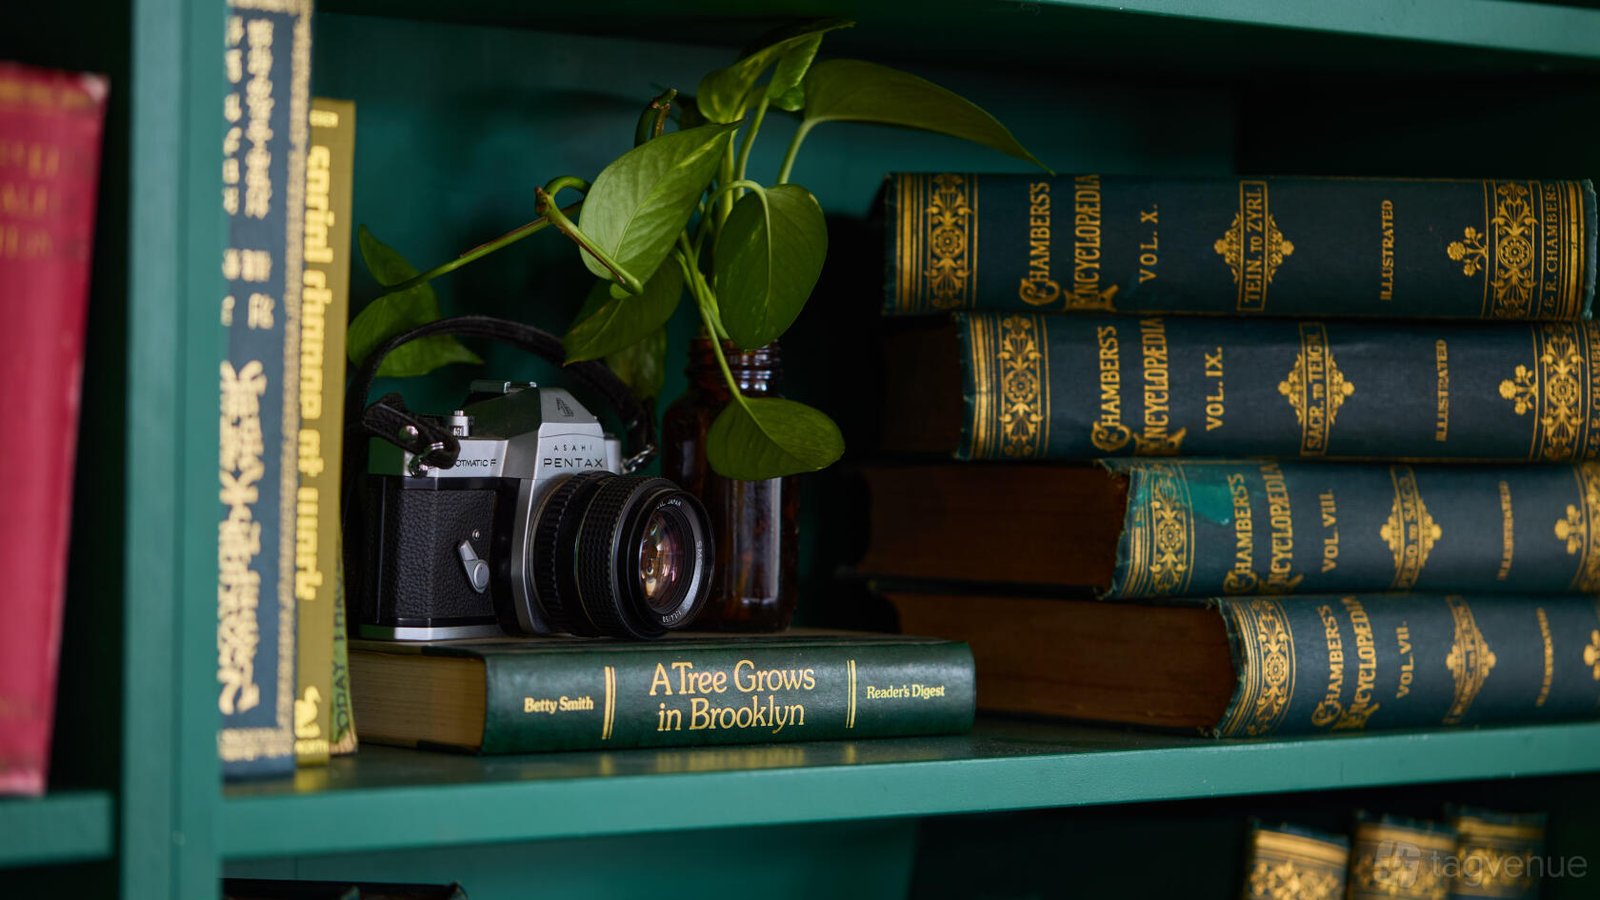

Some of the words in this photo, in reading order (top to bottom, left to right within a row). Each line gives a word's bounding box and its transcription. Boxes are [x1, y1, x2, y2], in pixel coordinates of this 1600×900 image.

[1140, 203, 1158, 224] X.
[1544, 183, 1558, 273] CHAMBERS
[1138, 231, 1158, 283] VOL.
[1249, 236, 1263, 253] TO
[1379, 199, 1395, 302] ILLUSTRATED
[1243, 255, 1263, 303] TEIN.
[1204, 346, 1224, 377] IX.
[1205, 381, 1225, 432] VOL.
[455, 459, 488, 467] OTMATIC
[543, 457, 604, 468] PENTAX
[553, 444, 594, 452] ASAHI
[649, 664, 673, 697] A
[671, 661, 727, 696] Tree
[733, 659, 815, 694] Grows
[866, 684, 910, 701] Reader's
[911, 683, 945, 700] Digest
[523, 697, 557, 715] Betty
[559, 696, 594, 712] Smith
[657, 702, 681, 733] in
[689, 695, 805, 735] Brooklyn
